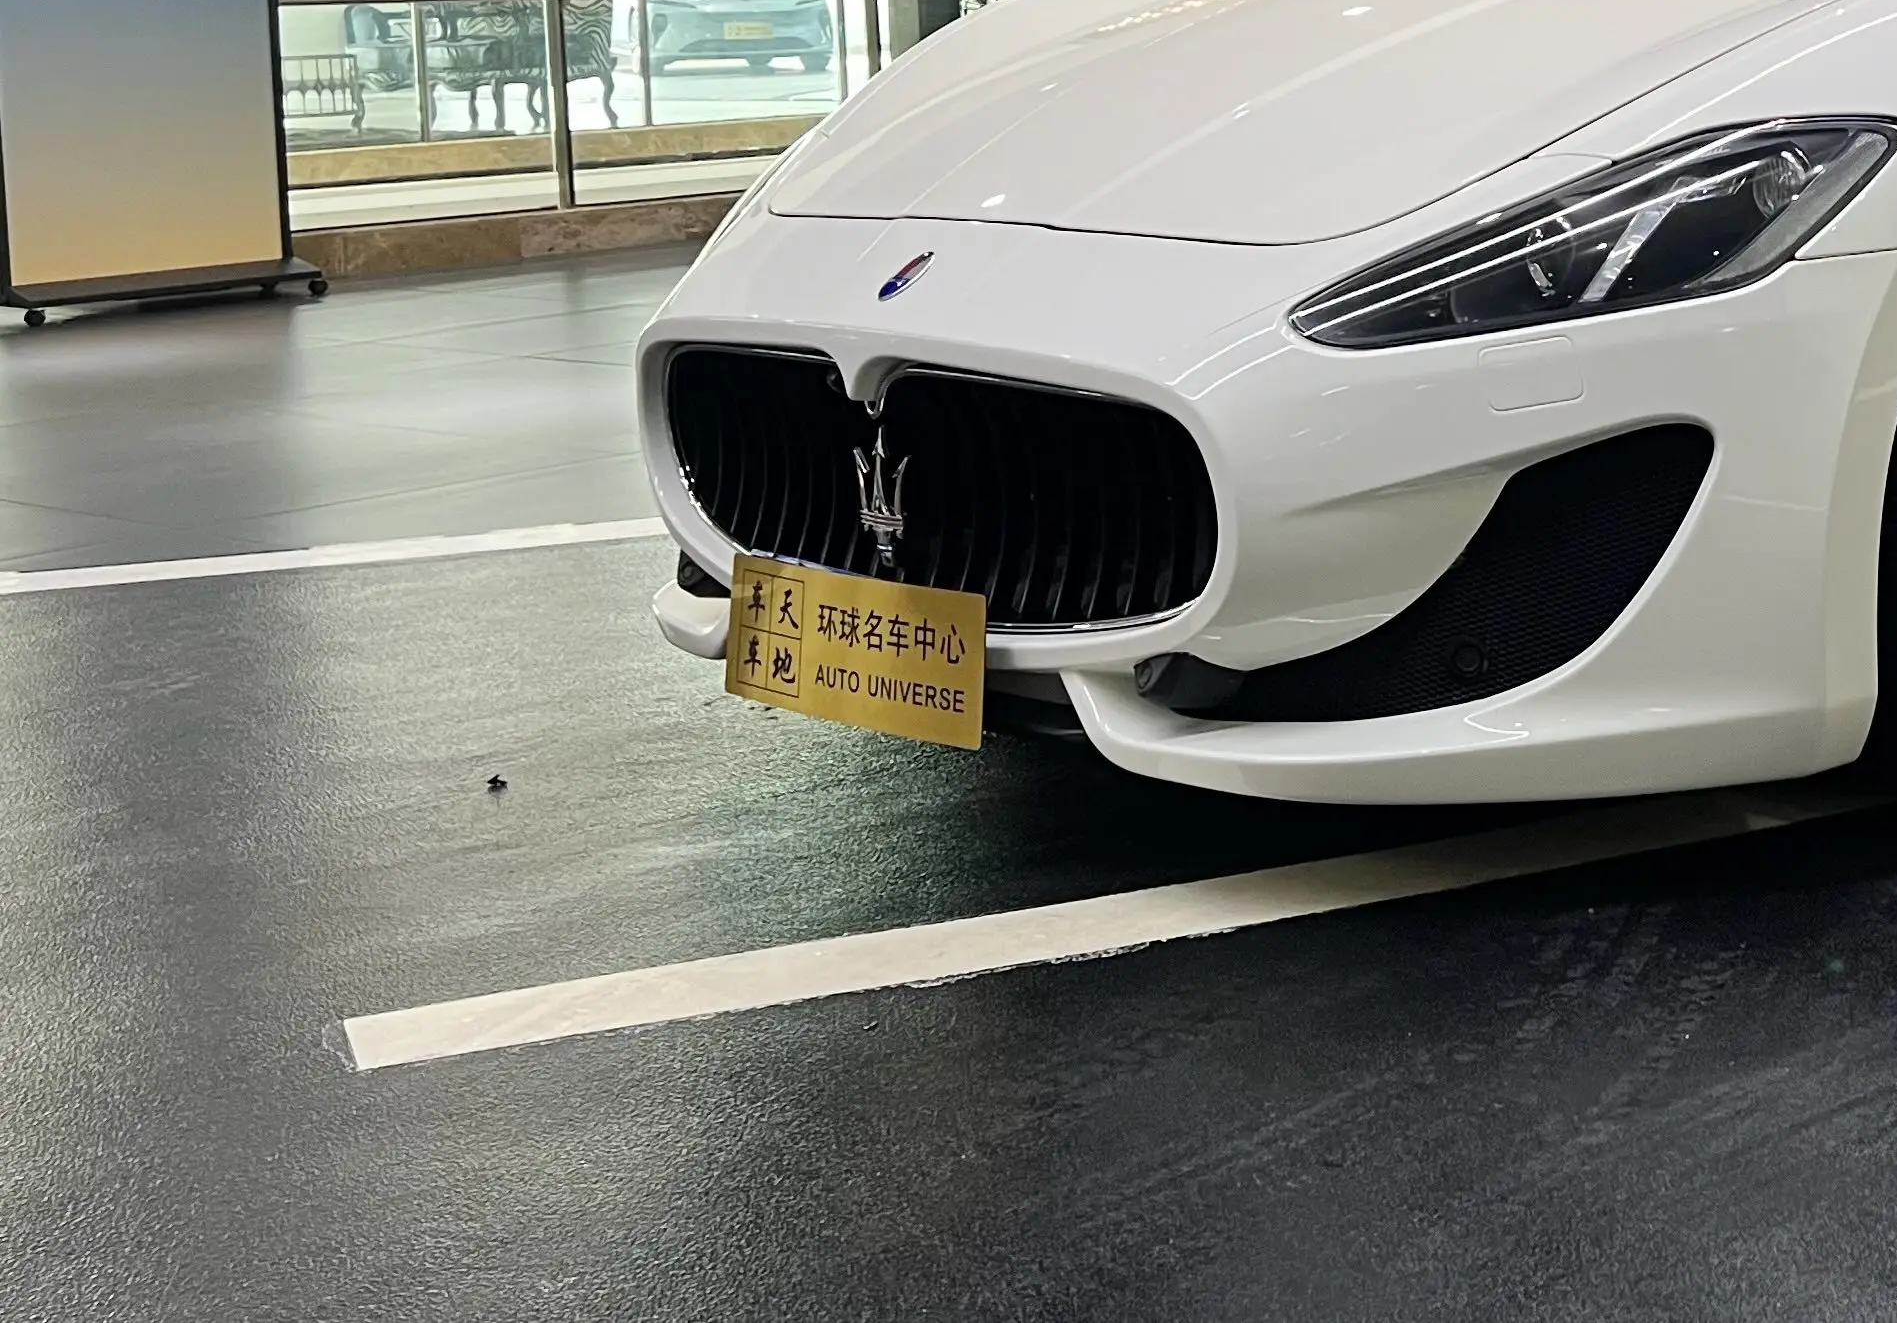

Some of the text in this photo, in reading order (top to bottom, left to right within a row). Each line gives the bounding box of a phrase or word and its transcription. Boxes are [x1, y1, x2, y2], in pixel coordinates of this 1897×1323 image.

[817, 604, 966, 664] 环球名车中心
[814, 663, 965, 714] AUTO UNIVERSE
